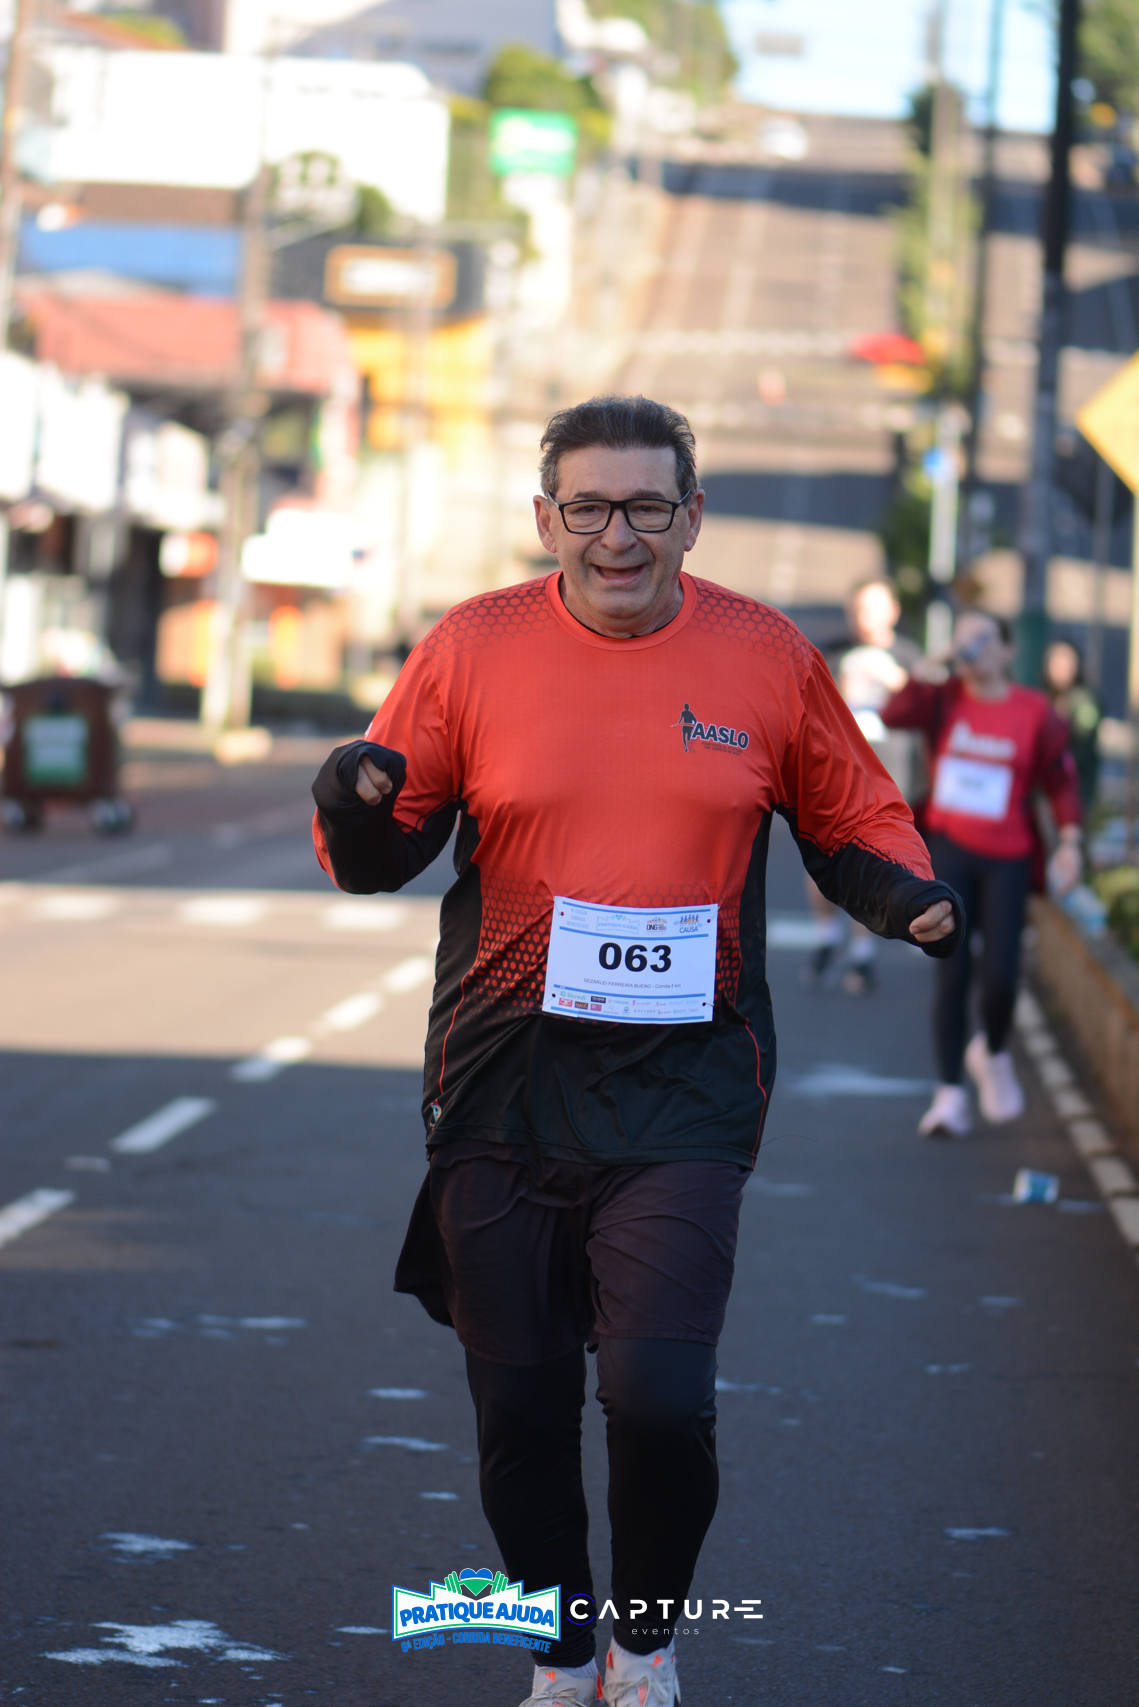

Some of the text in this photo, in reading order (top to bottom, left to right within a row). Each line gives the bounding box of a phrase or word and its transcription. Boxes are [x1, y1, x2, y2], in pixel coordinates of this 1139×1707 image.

[690, 722, 749, 749] AASLO
[598, 942, 672, 972] 063
[567, 992, 586, 1000] Sicredi
